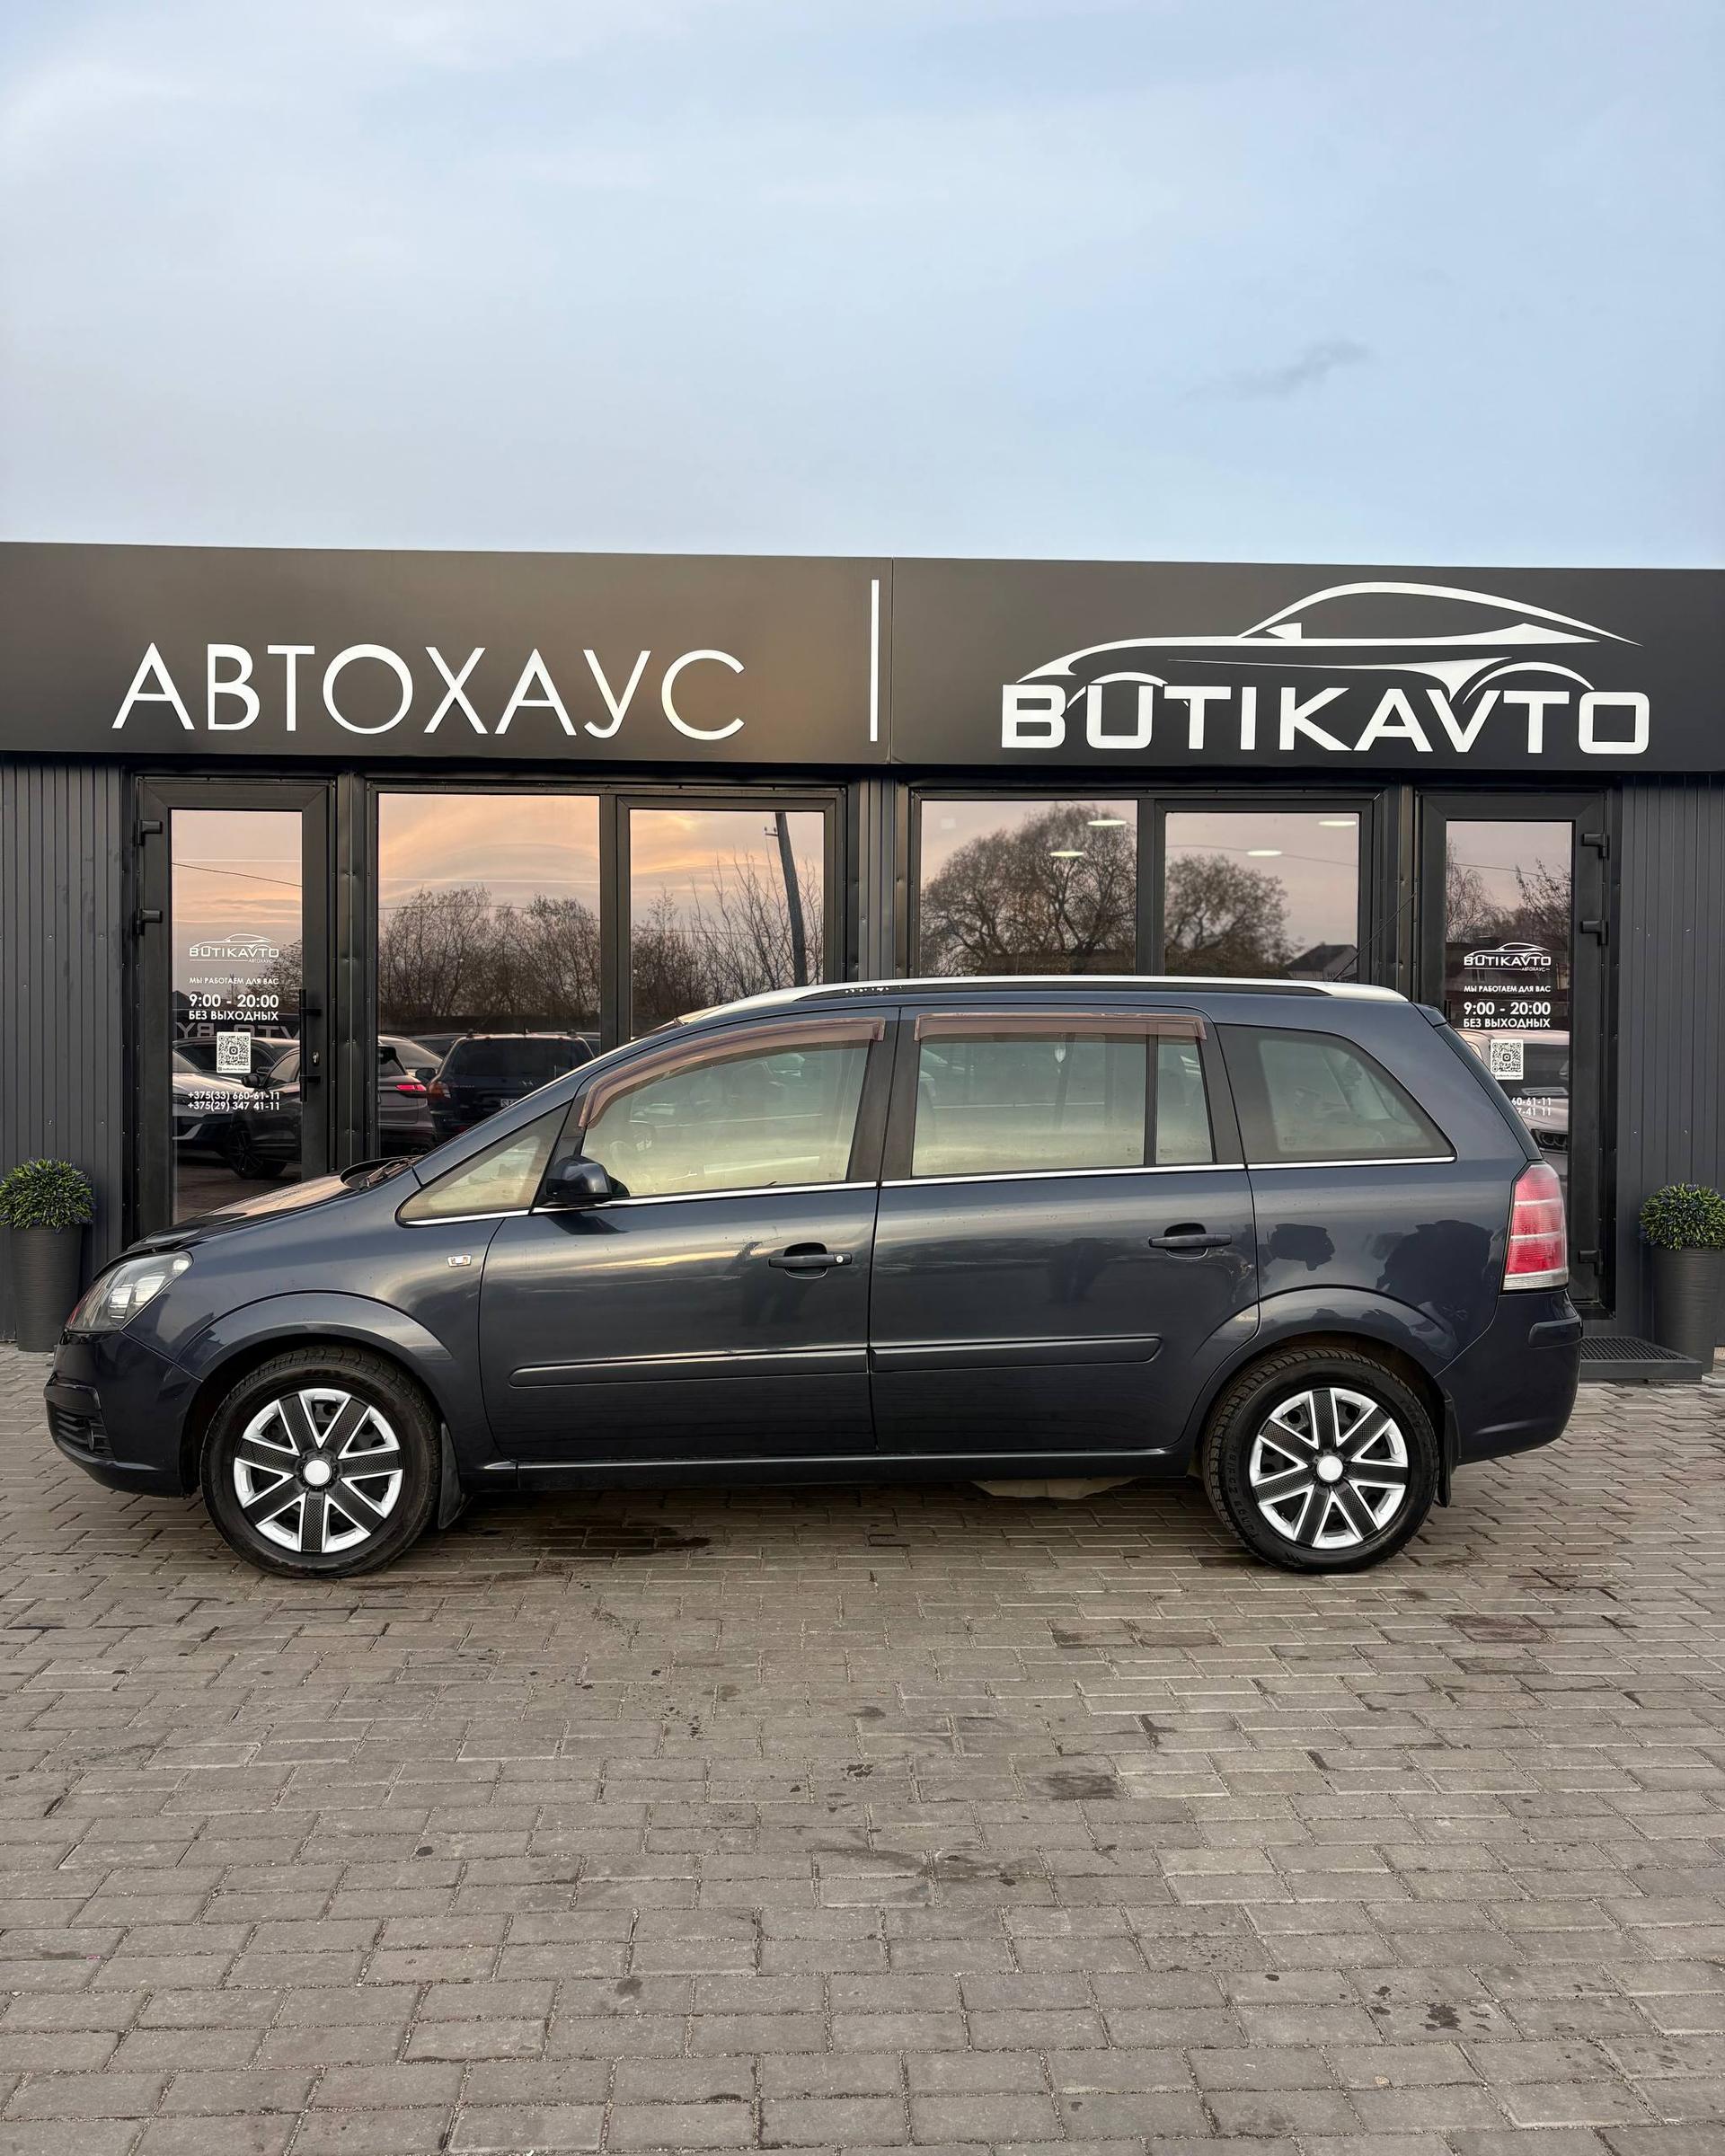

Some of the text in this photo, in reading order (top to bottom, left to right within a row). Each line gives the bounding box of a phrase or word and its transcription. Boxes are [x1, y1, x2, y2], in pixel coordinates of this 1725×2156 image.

[111, 642, 746, 740] АВТОХАУС
[1001, 684, 1650, 755] BUTIKAVTO
[189, 947, 279, 958] BUTIKAVTO
[1464, 956, 1552, 966] BUTIKAVTO
[204, 976, 244, 985] РАБОТАЕМ
[245, 977, 261, 985] ДЛЯ
[1518, 985, 1534, 994] ДЛЯ
[189, 994, 221, 1007] 9:00
[236, 994, 279, 1008] 20:00
[1464, 1002, 1495, 1015] 9:00
[1510, 1002, 1552, 1015] 20:00
[189, 1011, 279, 1021] БЕЗ ВЫХОДНЫХ
[1464, 1018, 1551, 1029] БЕЗ ВЫХОДНЫХ
[188, 1091, 280, 1100] +375(33) 660-61-11
[188, 1101, 230, 1111] +375(29)
